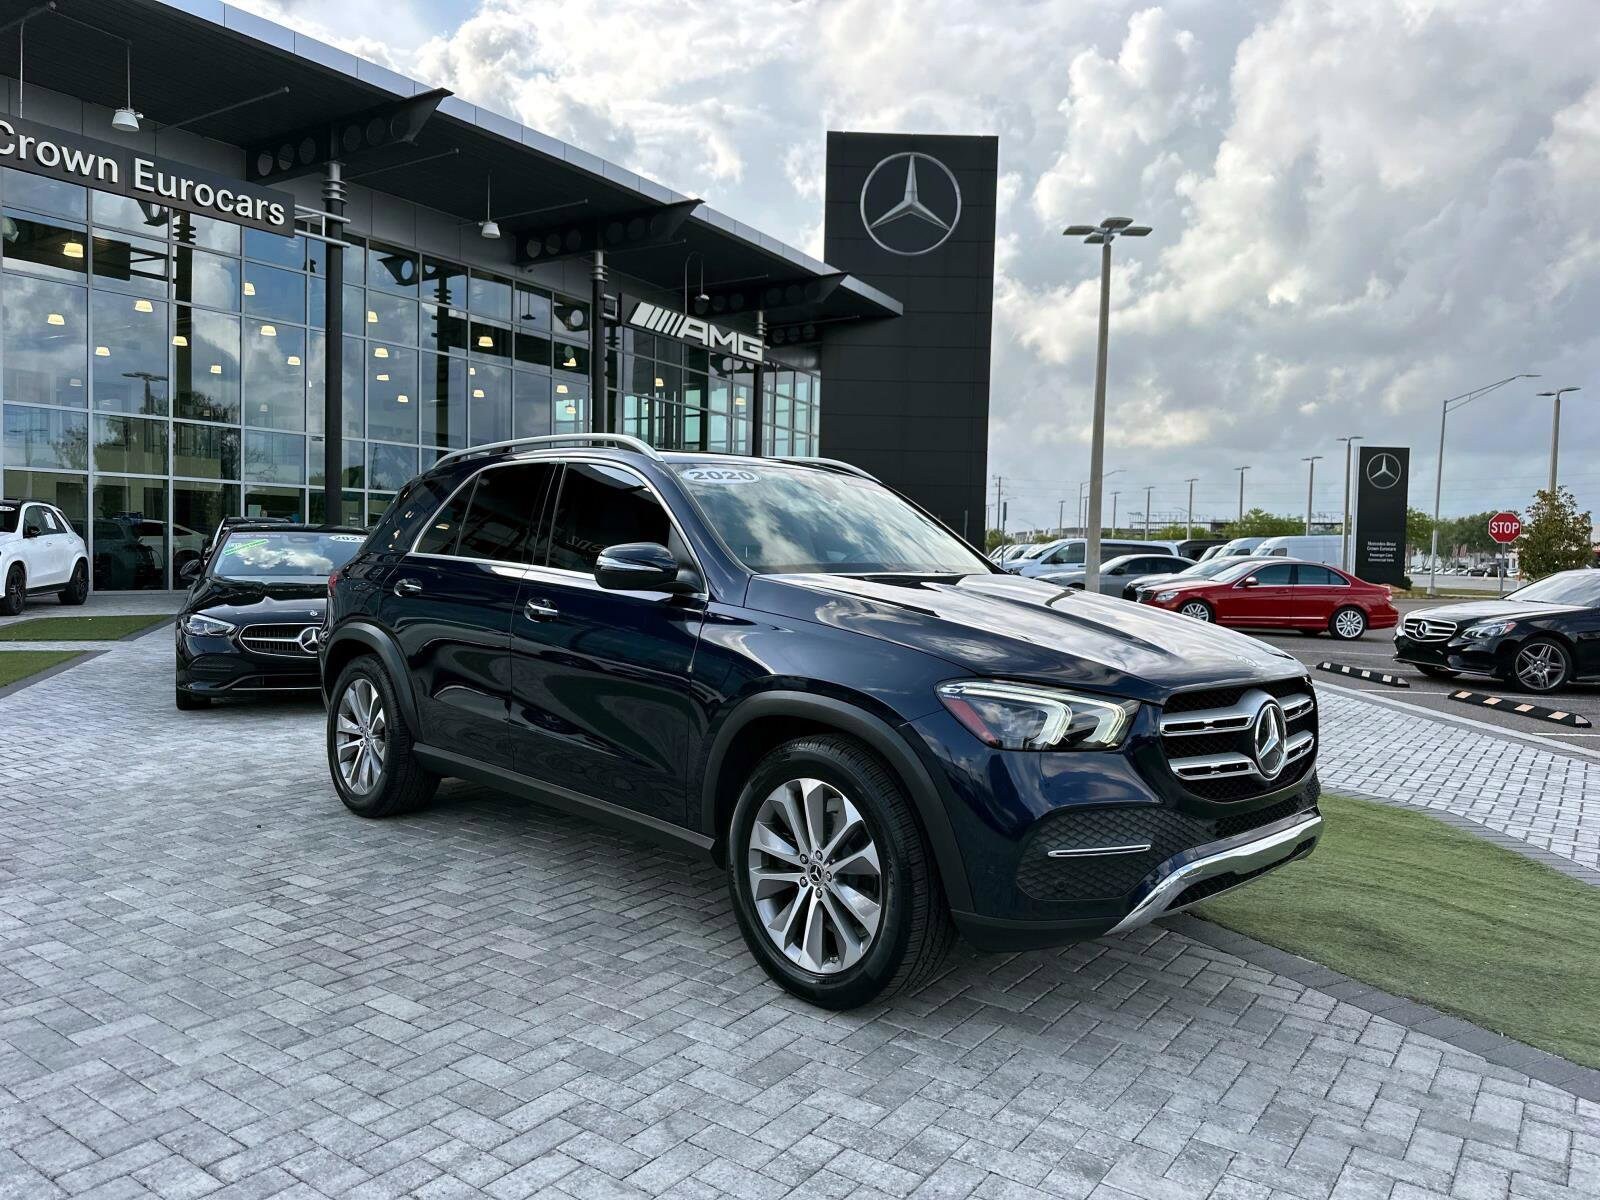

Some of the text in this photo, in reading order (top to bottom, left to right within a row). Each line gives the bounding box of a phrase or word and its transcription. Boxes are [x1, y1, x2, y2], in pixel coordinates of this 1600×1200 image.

[0, 120, 285, 226] Crown Eurocars
[676, 317, 763, 362] AMG
[689, 471, 754, 480] 2020
[1491, 522, 1519, 534] STOP
